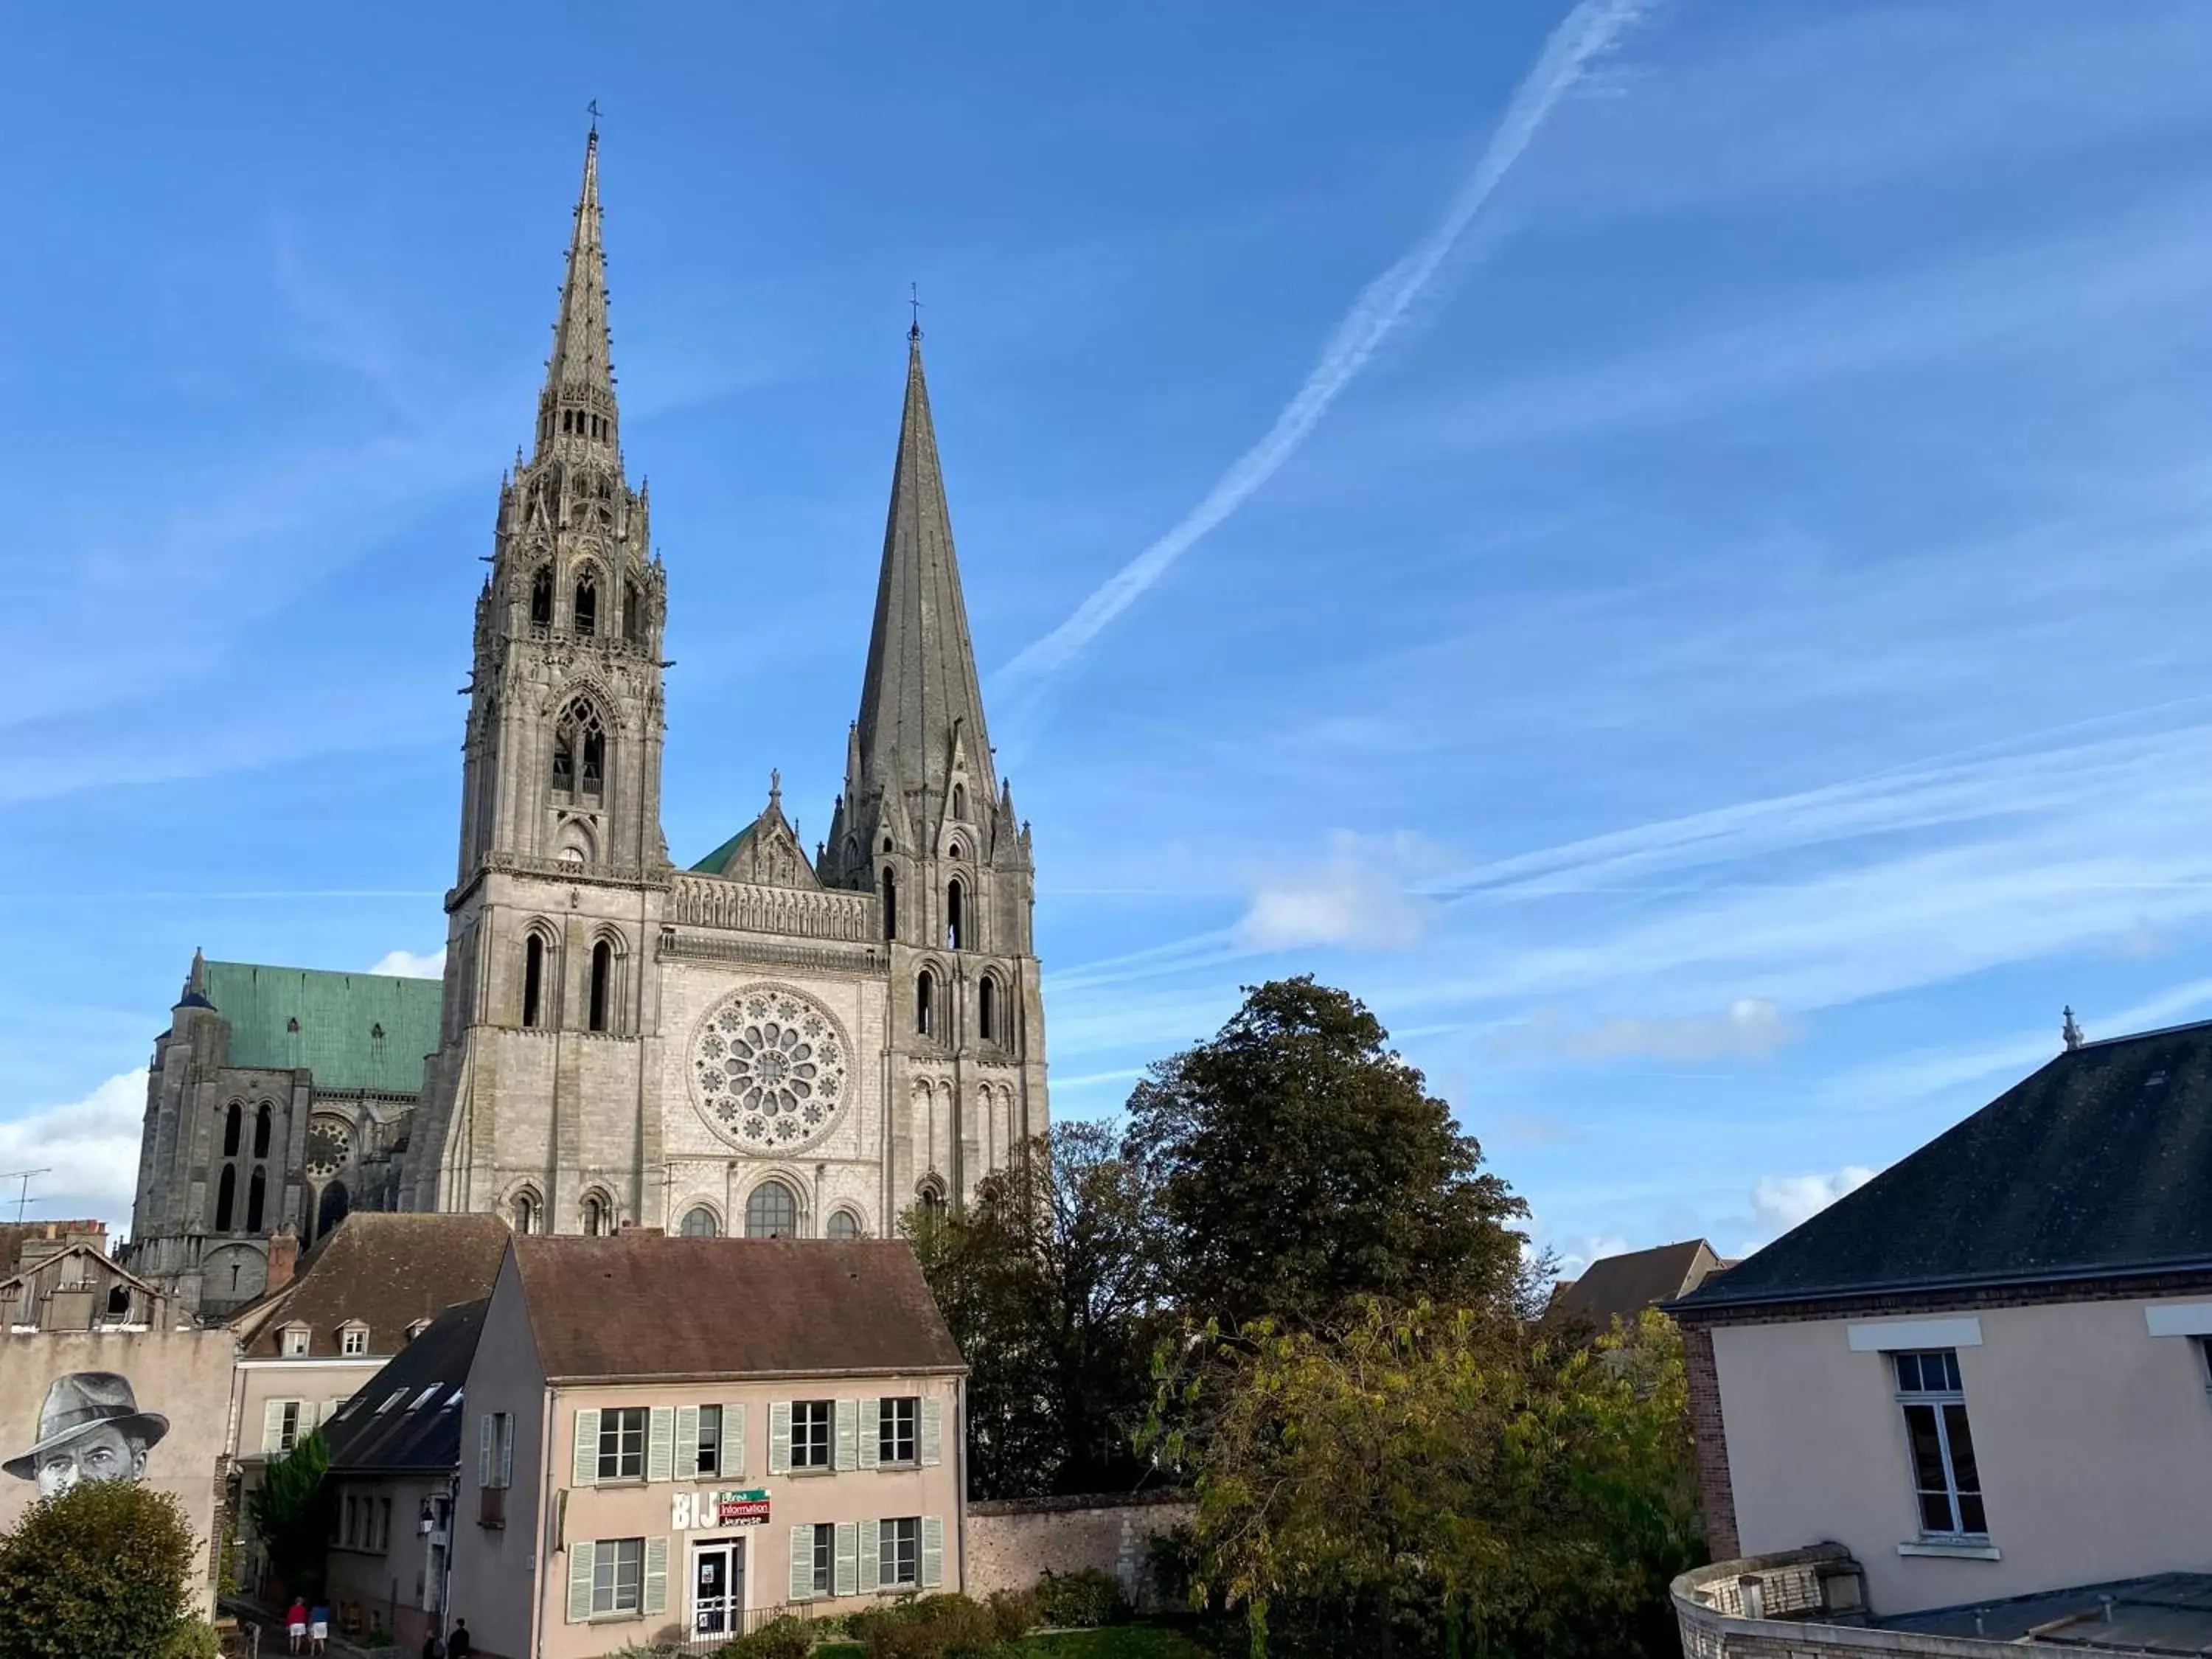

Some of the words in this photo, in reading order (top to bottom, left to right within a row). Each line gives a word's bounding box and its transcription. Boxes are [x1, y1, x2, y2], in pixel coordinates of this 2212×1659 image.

[672, 1492, 717, 1530] BIJ
[722, 1503, 767, 1514] Information
[721, 1517, 762, 1527] Jeunesse
